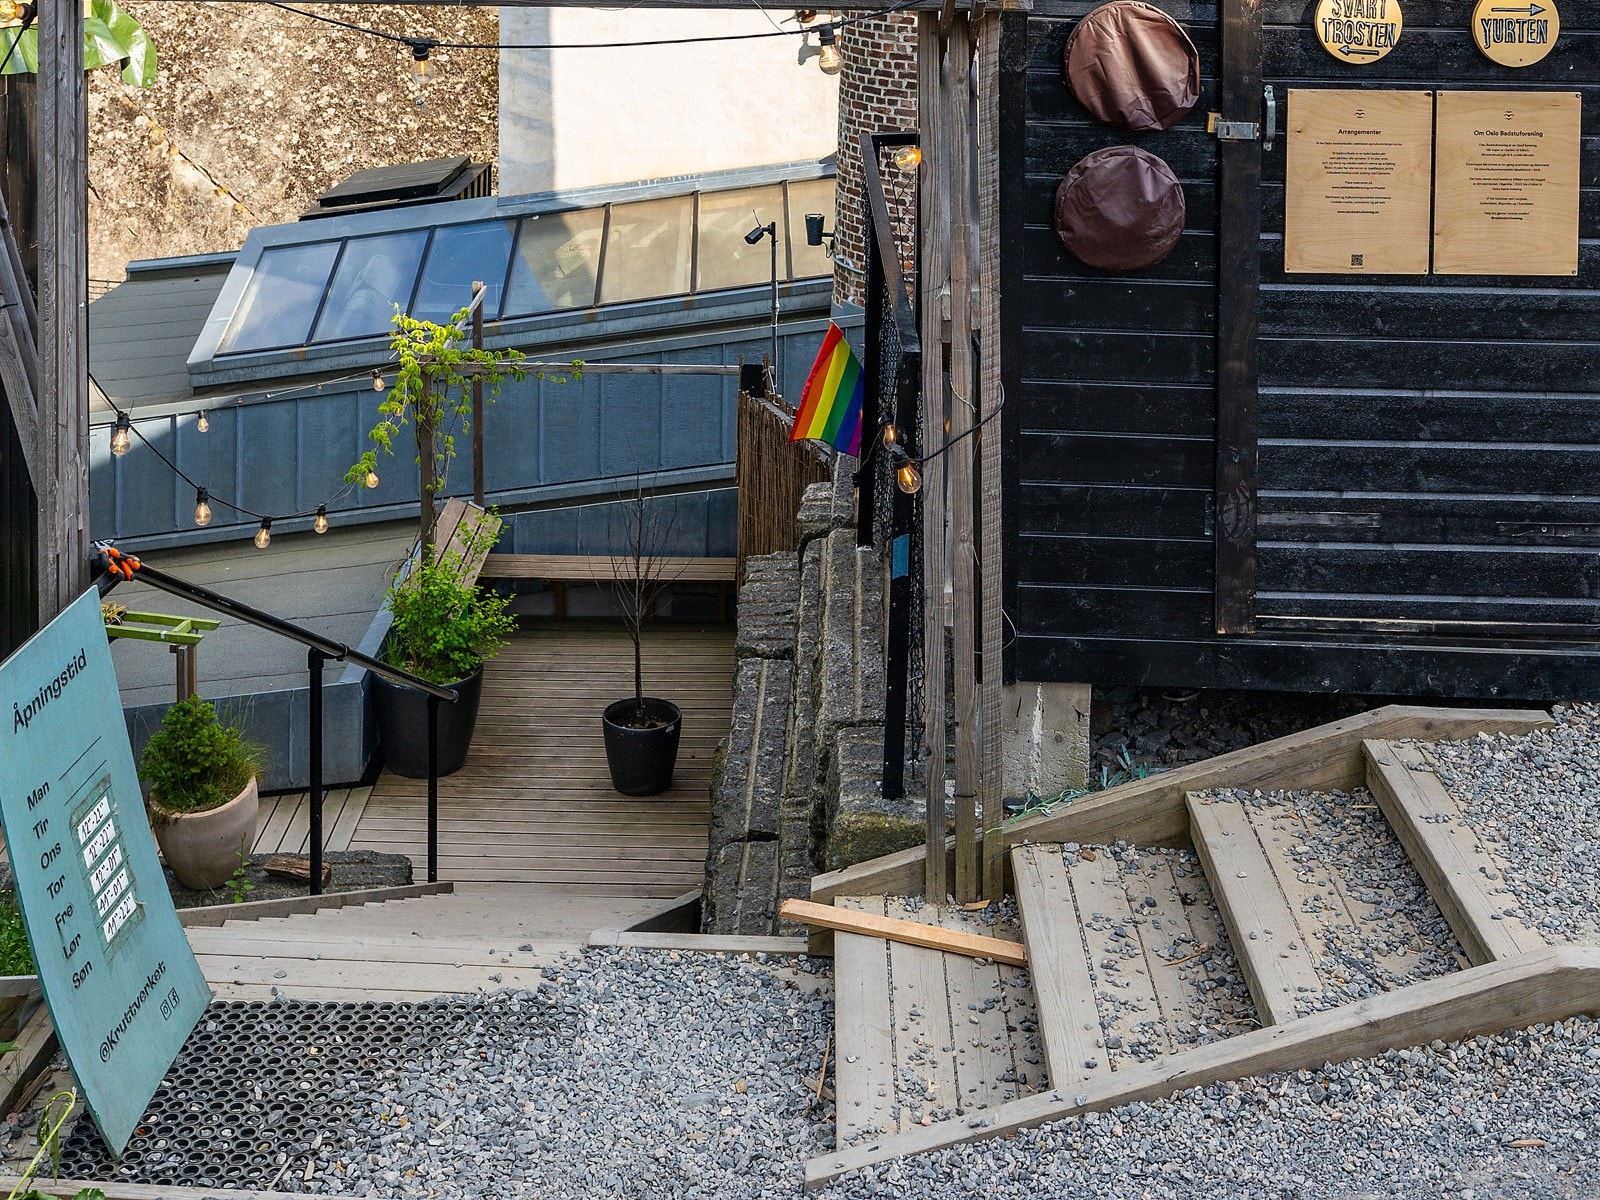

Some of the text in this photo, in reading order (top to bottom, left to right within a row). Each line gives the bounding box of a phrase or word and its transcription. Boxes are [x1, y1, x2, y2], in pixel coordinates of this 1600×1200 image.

[1322, 18, 1397, 49] TROSTEN
[1480, 18, 1549, 49] YURTEN
[13, 647, 88, 735] Åpningstid
[26, 781, 50, 811] Man
[32, 817, 49, 840] Tir
[40, 841, 62, 870] Ons
[46, 874, 66, 901] Tor
[55, 902, 74, 932] Fre
[62, 932, 82, 961] Lør
[71, 960, 93, 990] Søn
[99, 960, 166, 1063] @Kruttverket
